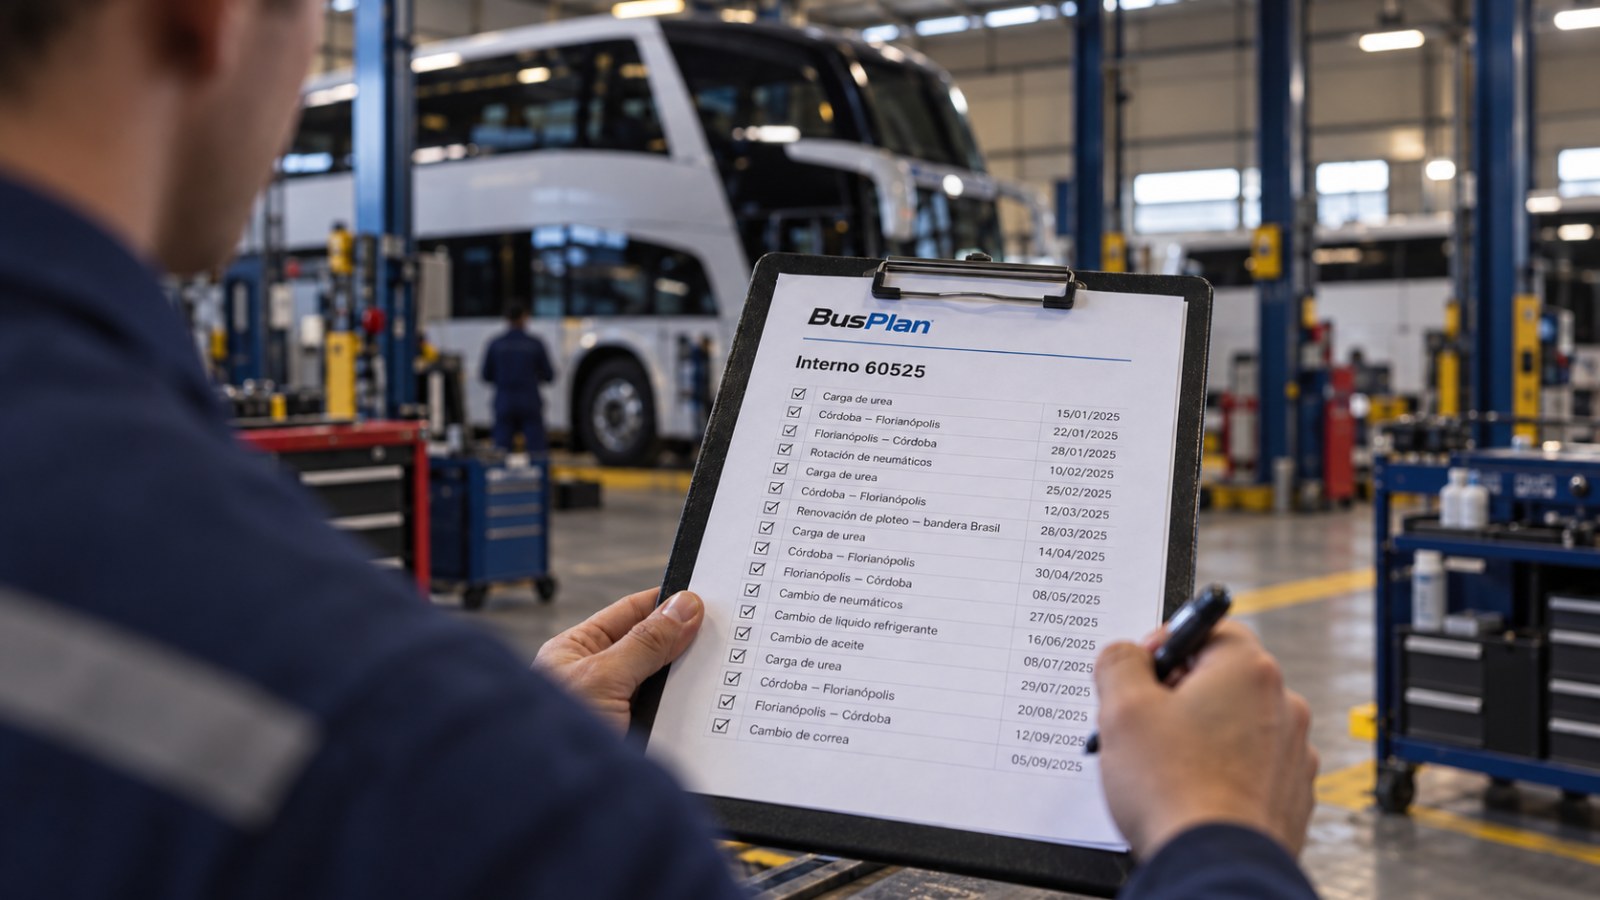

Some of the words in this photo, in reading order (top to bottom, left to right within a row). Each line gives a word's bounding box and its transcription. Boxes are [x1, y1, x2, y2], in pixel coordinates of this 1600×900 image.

[807, 307, 932, 335] BusPlan
[796, 355, 860, 373] Interno
[865, 361, 926, 378] 60525
[822, 391, 853, 404] Carga
[855, 395, 868, 404] de
[870, 397, 893, 406] urea
[819, 410, 862, 422] Córdoba
[876, 415, 940, 429] Florianópolis
[1058, 409, 1120, 422] 15/01/2025
[815, 429, 878, 443] Florianópolis
[893, 436, 937, 448] Córdoba
[1053, 427, 1118, 440] 22/01/2025
[810, 448, 855, 460] Rotación
[857, 452, 870, 462] de
[873, 456, 932, 467] neumáticos
[1051, 446, 1116, 459] 28/01/2025
[806, 467, 836, 480] Carga
[839, 470, 852, 479] de
[854, 474, 877, 482] urea
[1050, 466, 1114, 479] 10/02/2025
[802, 487, 845, 499] Córdoba
[860, 492, 926, 506] Florianópolis
[1046, 486, 1111, 498] 25/02/2025
[797, 506, 856, 520] Renovación
[860, 512, 873, 522] de
[875, 514, 909, 525] ploteo
[924, 517, 968, 530] bandera
[970, 521, 1000, 532] Brasil
[1044, 506, 1109, 519] 12/03/2025
[792, 526, 823, 539] Carga
[826, 530, 840, 539] de
[843, 533, 865, 542] urea
[1040, 526, 1107, 540] 28/03/2025
[788, 547, 833, 560] Córdoba
[848, 552, 915, 568] Florianópolis
[1039, 547, 1105, 561] 14/04/2025
[784, 567, 850, 582] Florianópolis
[866, 575, 912, 588] Córdoba
[1036, 568, 1102, 583] 30/04/2025
[780, 588, 820, 601] Cambio
[823, 593, 836, 603] de
[839, 596, 902, 609] neumáticos
[1032, 590, 1100, 605] 08/05/2025
[775, 610, 816, 623] Cambio
[819, 614, 832, 624] de
[874, 620, 938, 635] refrigerante
[1030, 612, 1098, 627] 27/05/2025
[770, 632, 812, 645] Cambio
[814, 636, 828, 646] de
[831, 640, 864, 650] aceite
[1028, 634, 1095, 650] 16/06/2025
[766, 654, 797, 668] Carga
[801, 658, 814, 668] de
[818, 662, 842, 671] urea
[1024, 656, 1093, 673] 08/07/2025
[760, 677, 807, 691] Córdoba
[823, 684, 894, 700] Florianópolis
[1021, 680, 1090, 697] 29/07/2025
[755, 700, 826, 717] Florianópolis
[842, 710, 891, 724] Córdoba
[1018, 704, 1087, 721] 20/08/2025
[750, 724, 792, 738] Cambio
[796, 730, 810, 740] de
[813, 734, 849, 744] correa
[1016, 730, 1085, 746] 12/09/2025
[1012, 754, 1082, 772] 05/09/2025
